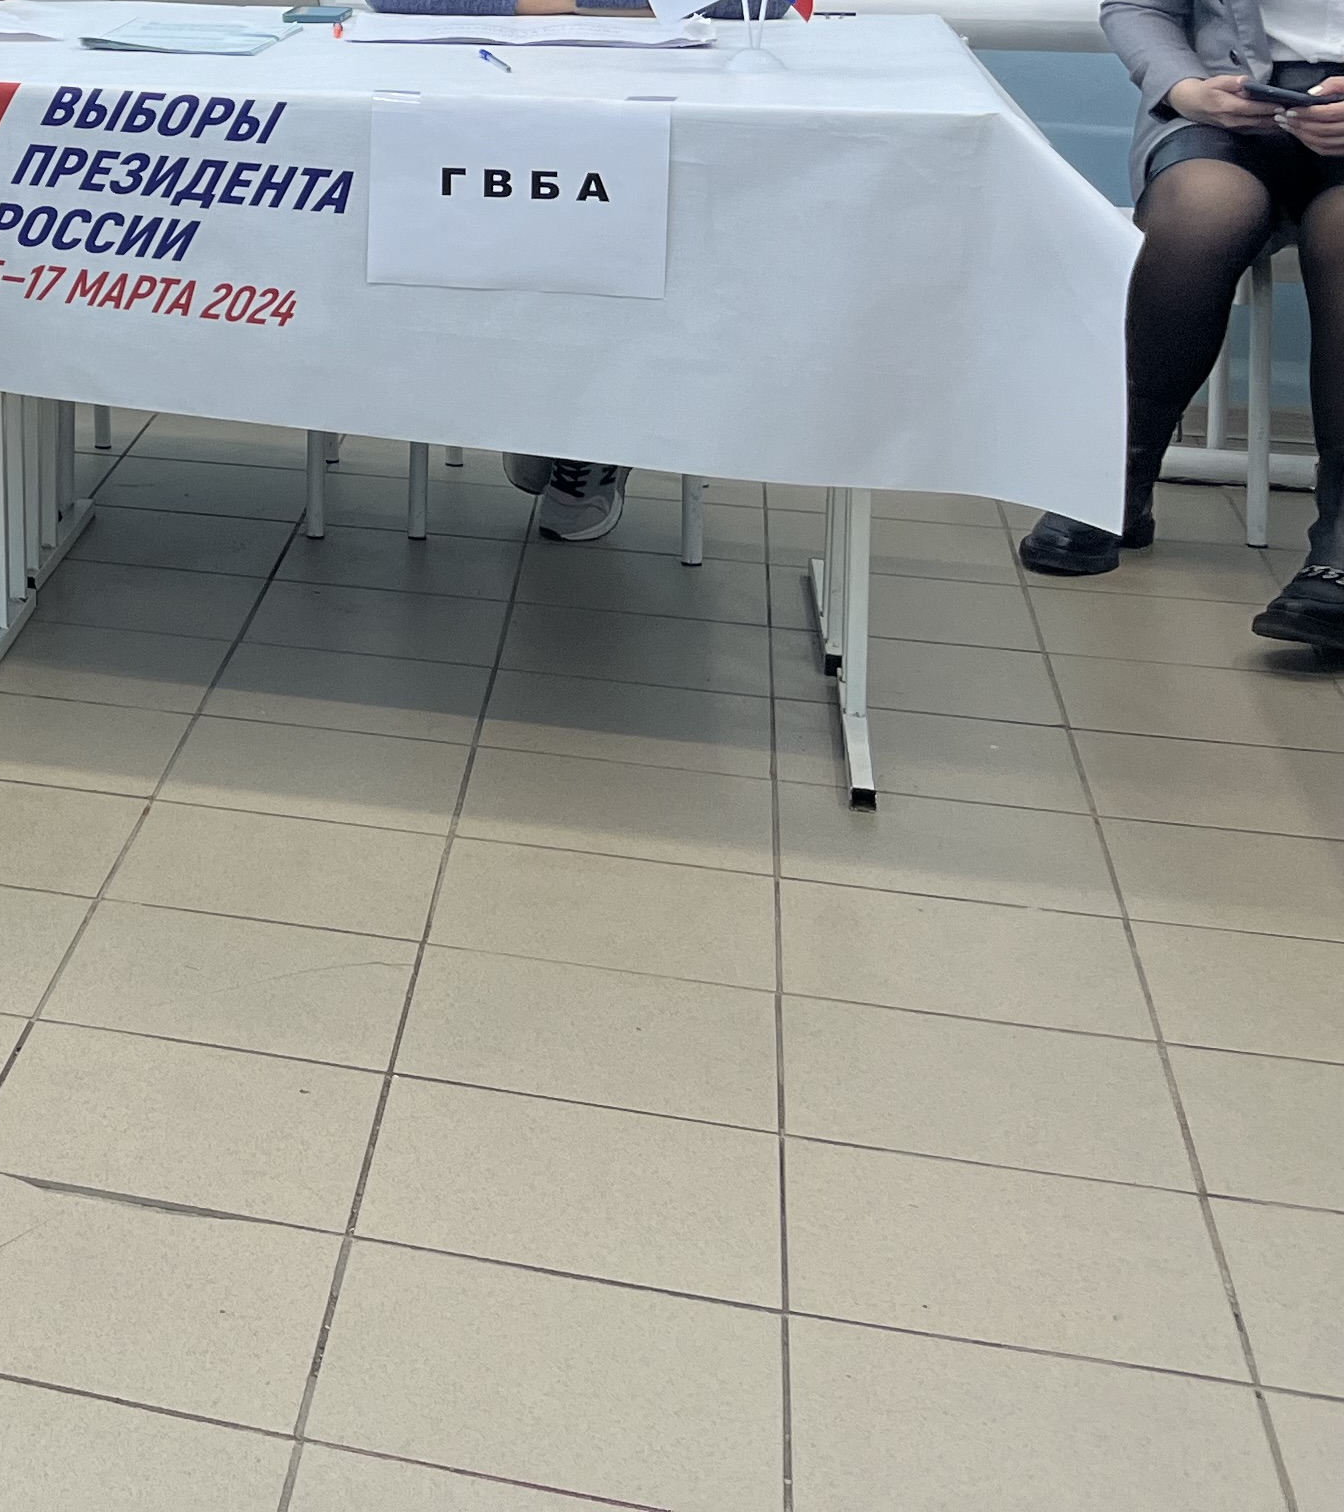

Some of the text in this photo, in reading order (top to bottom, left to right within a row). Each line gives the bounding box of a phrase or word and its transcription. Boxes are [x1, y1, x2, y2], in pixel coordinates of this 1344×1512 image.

[40, 85, 288, 145] ВЫБОРЫ
[10, 144, 355, 215] ПРЕЗИДЕНТА
[64, 268, 197, 320] МАРТА
[199, 282, 299, 327] 2024
